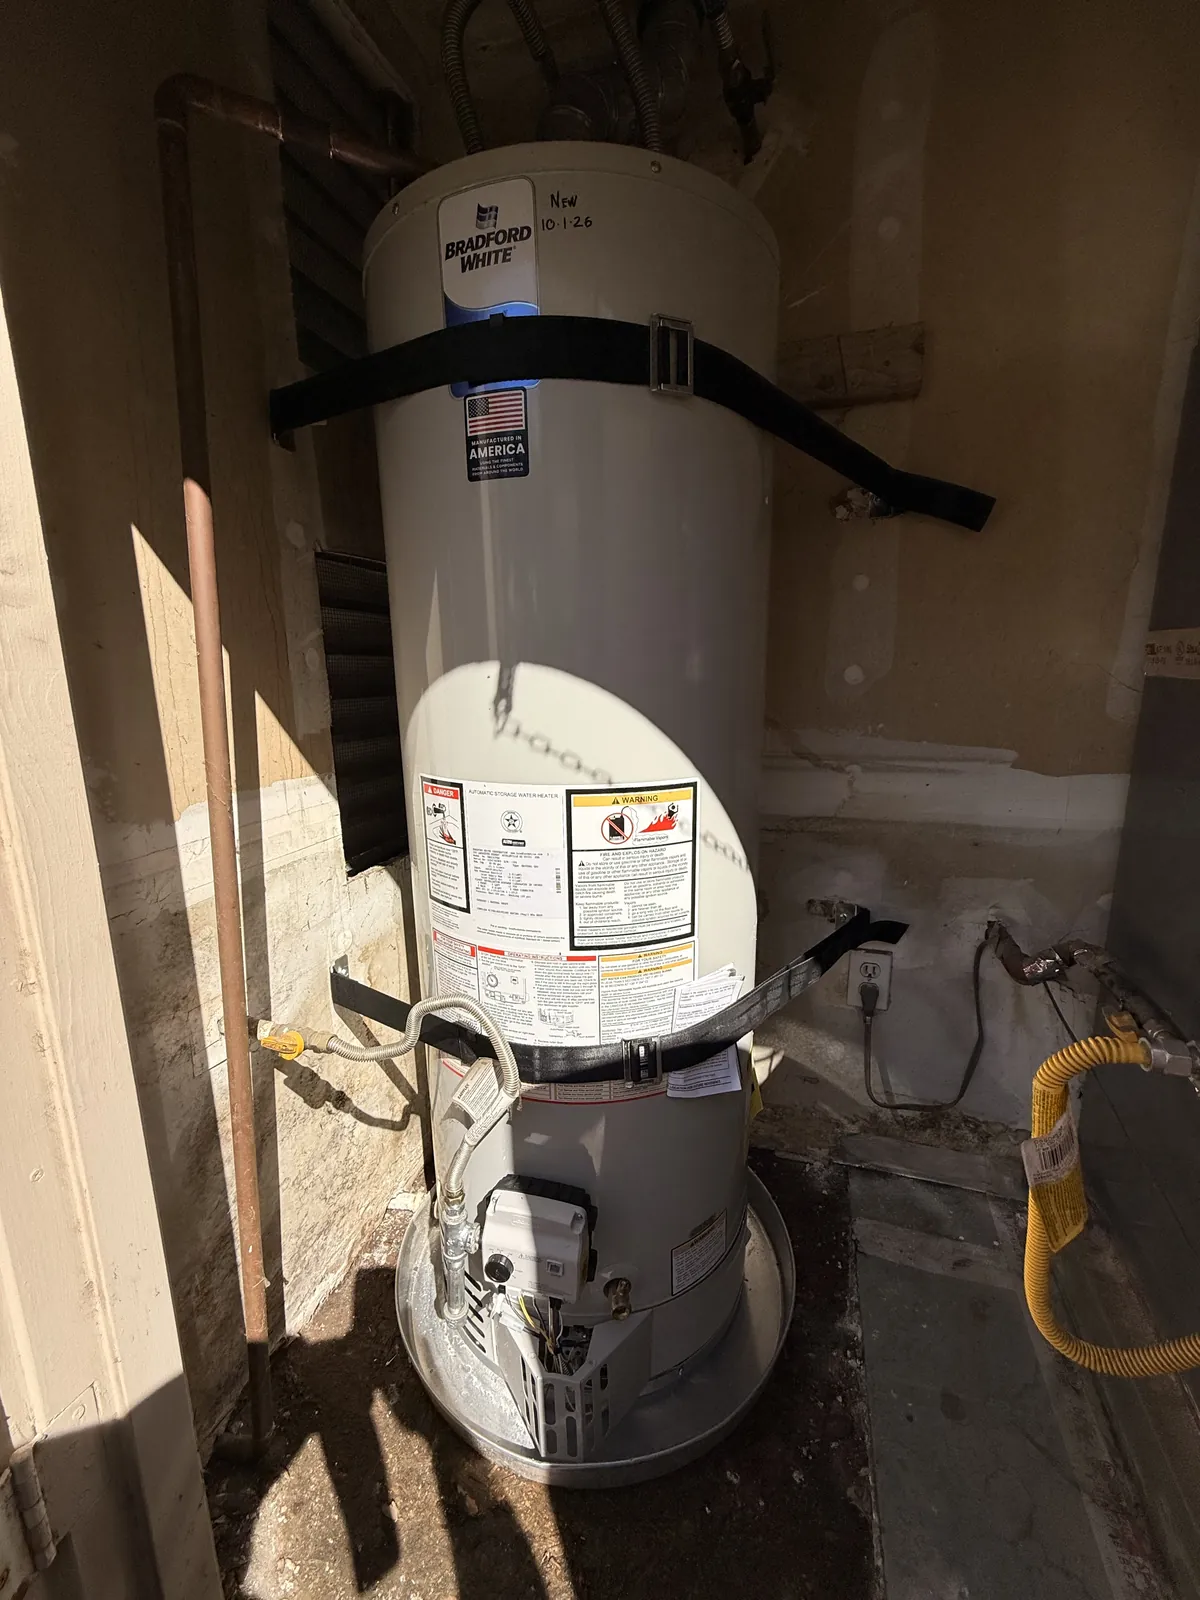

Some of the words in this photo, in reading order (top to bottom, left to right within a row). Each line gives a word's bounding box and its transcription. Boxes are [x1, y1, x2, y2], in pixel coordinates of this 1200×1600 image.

[445, 226, 532, 261] BRADFORD
[472, 436, 514, 446] MANUFACTURED
[470, 443, 525, 459] AMERICA
[433, 788, 455, 797] DANGER
[622, 795, 658, 803] WARNING
